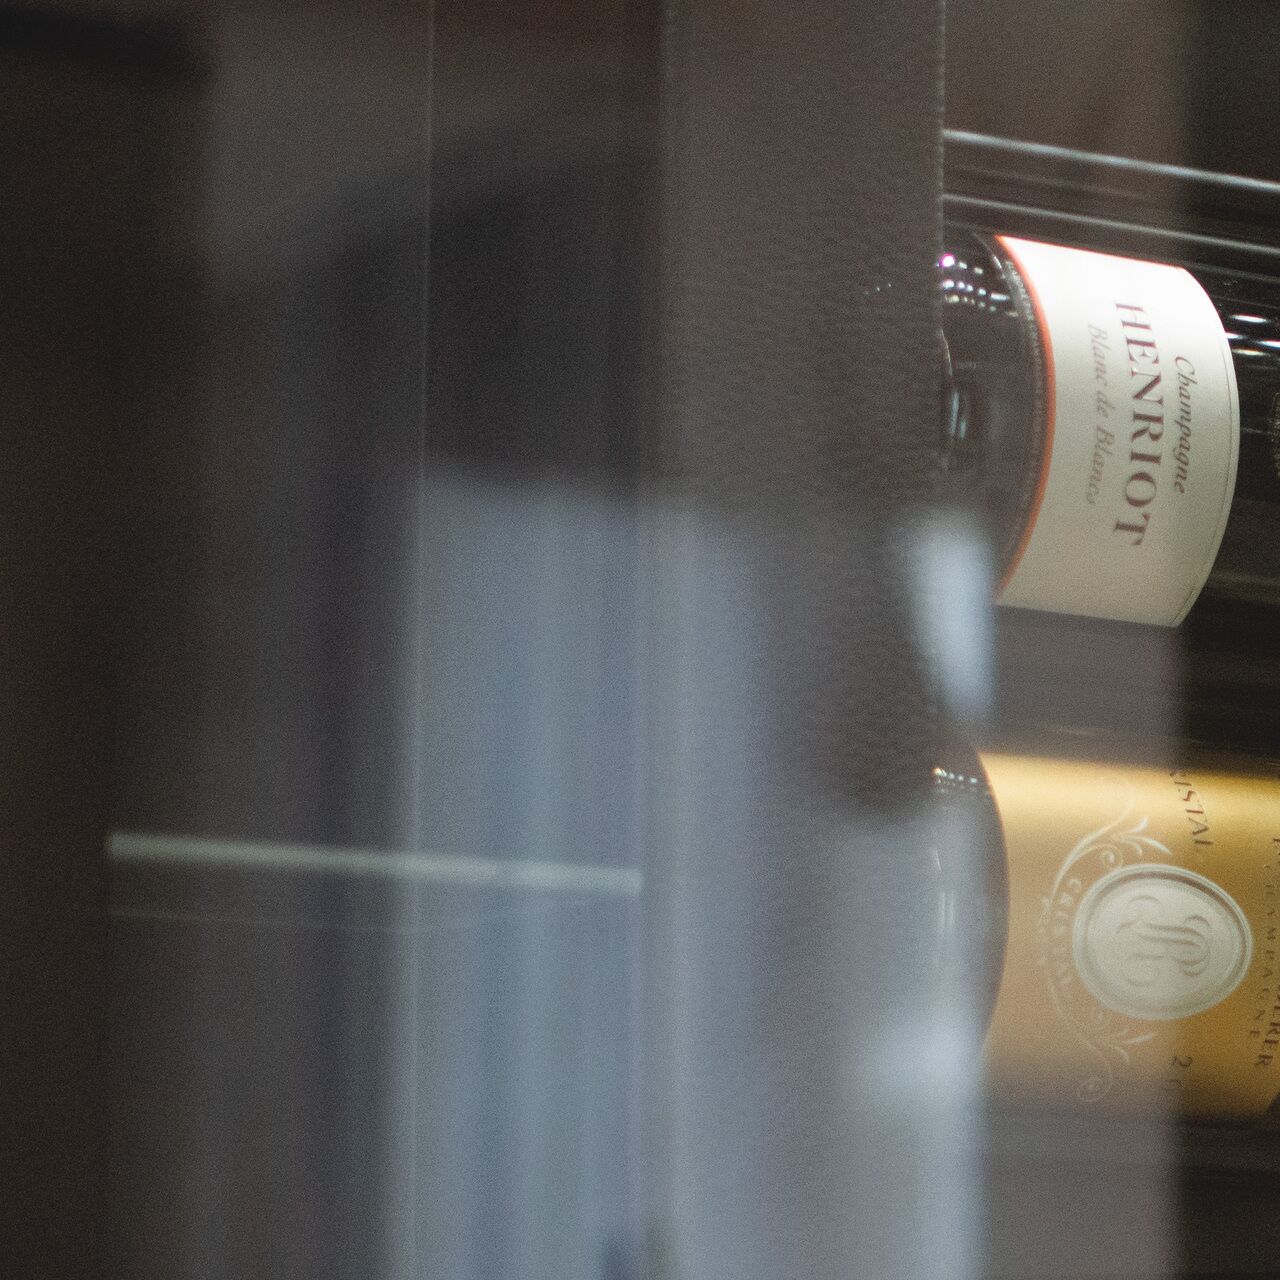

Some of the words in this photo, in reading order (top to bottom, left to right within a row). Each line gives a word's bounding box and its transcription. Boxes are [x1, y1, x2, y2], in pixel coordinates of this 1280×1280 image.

[1088, 323, 1112, 388] Blanc
[1095, 389, 1117, 418] de
[1112, 300, 1165, 547] HENRIOT
[1173, 355, 1199, 495] Champagne
[1086, 424, 1116, 506] Blancs
